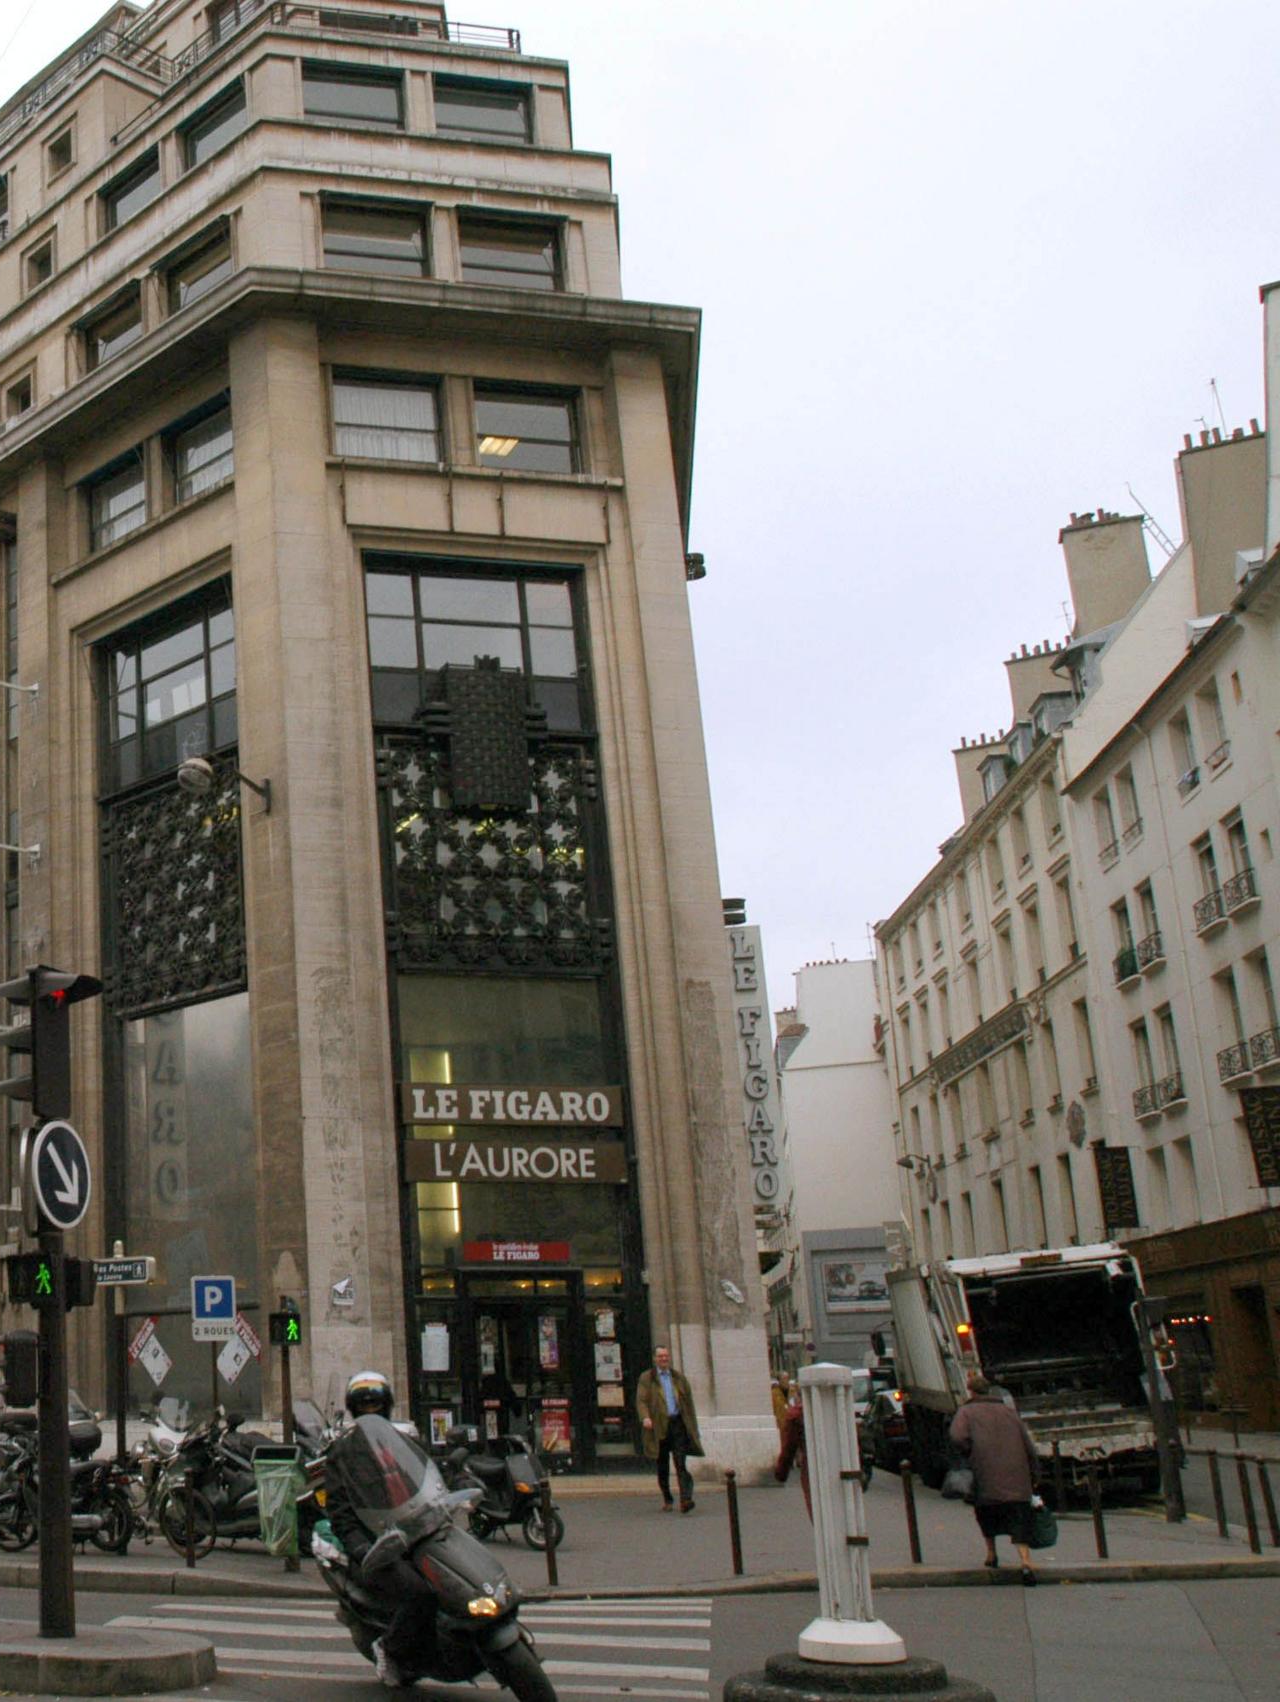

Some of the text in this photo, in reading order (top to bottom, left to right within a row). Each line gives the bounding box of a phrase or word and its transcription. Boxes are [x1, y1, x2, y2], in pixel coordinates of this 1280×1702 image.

[730, 930, 778, 1200] LE FIGARO
[412, 1088, 610, 1122] LE FIGARO
[434, 1142, 596, 1178] L'AURORE
[493, 1251, 540, 1260] LE FIGARO
[204, 1286, 223, 1312] P
[194, 1327, 235, 1335] 2 ROUES
